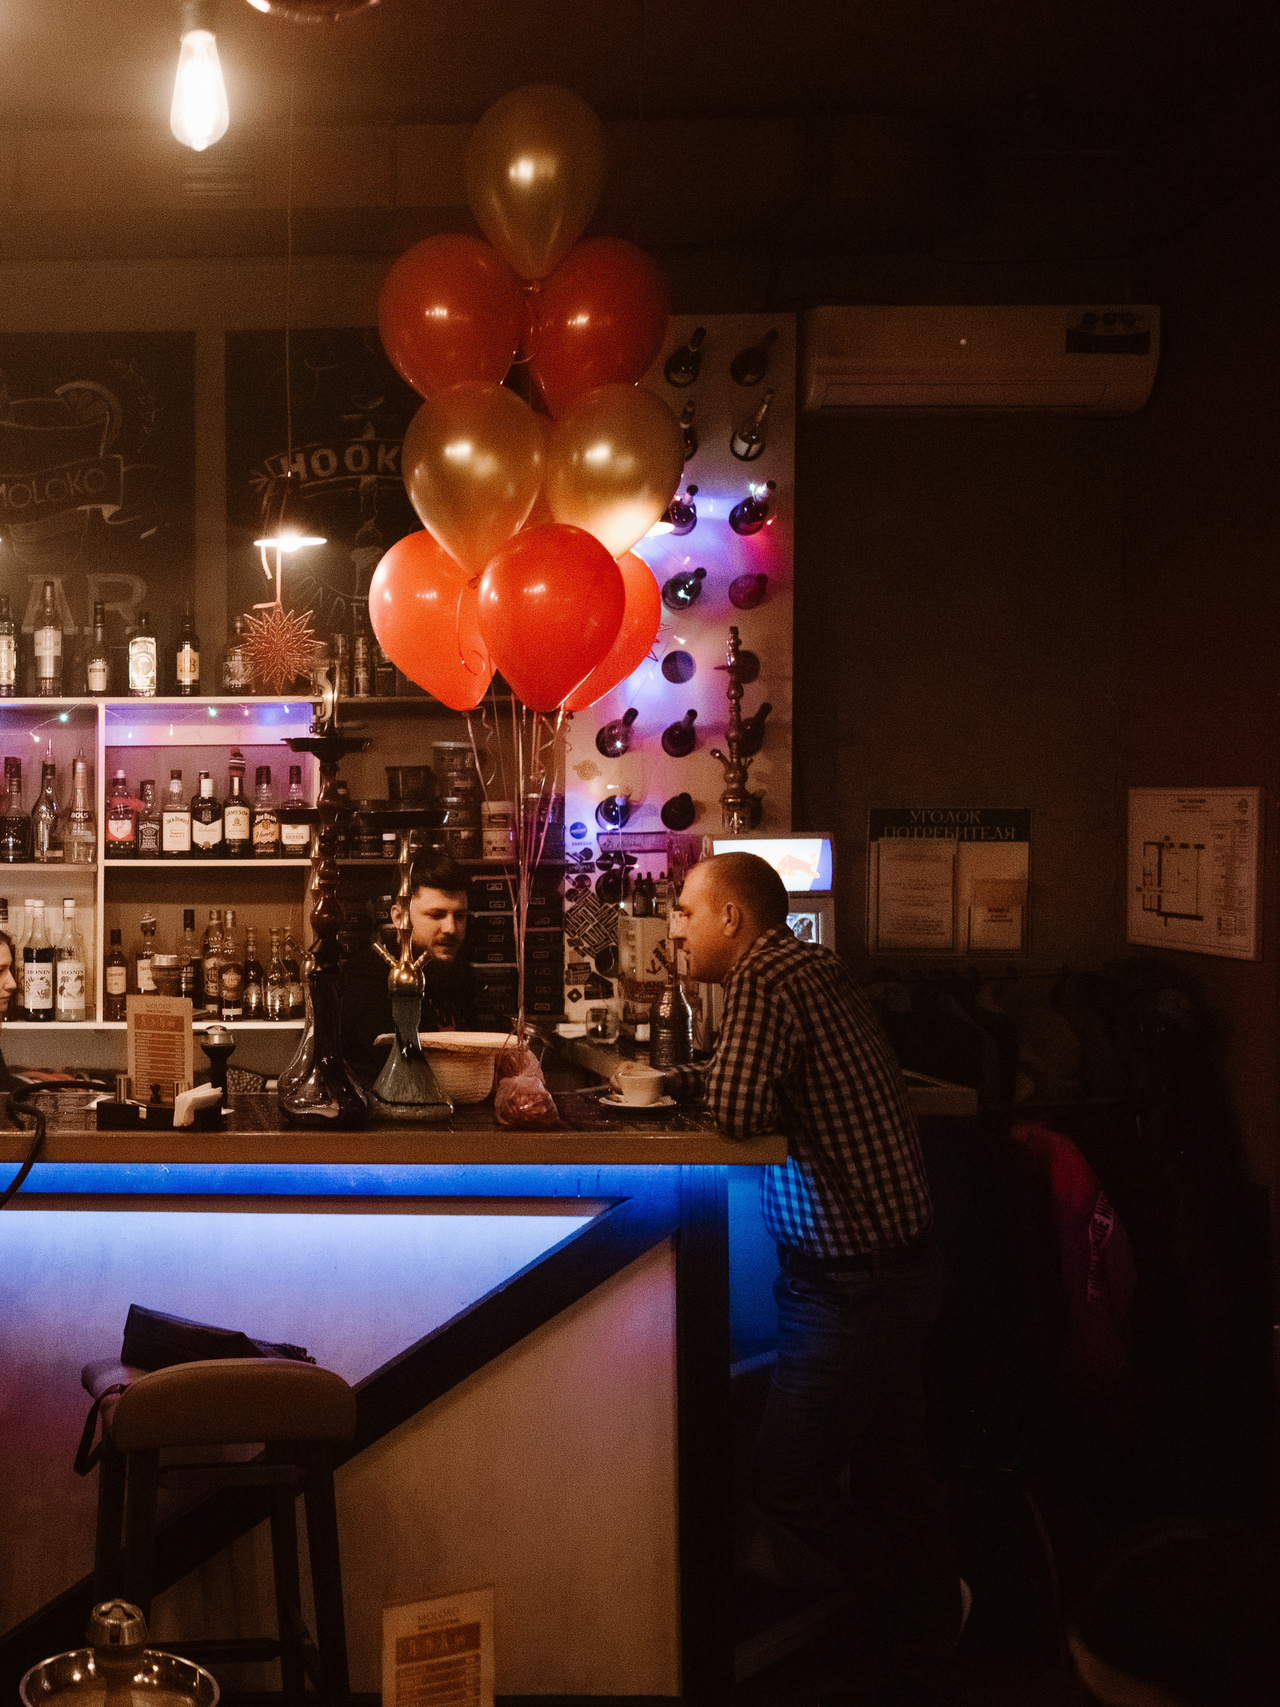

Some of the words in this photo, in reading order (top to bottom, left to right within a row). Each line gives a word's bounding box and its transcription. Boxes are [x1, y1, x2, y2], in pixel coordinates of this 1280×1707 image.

[279, 444, 402, 483] HOOK
[909, 810, 982, 824] УГОЛОК
[884, 827, 1016, 840] ПОТРЕБИТЕЛЯ
